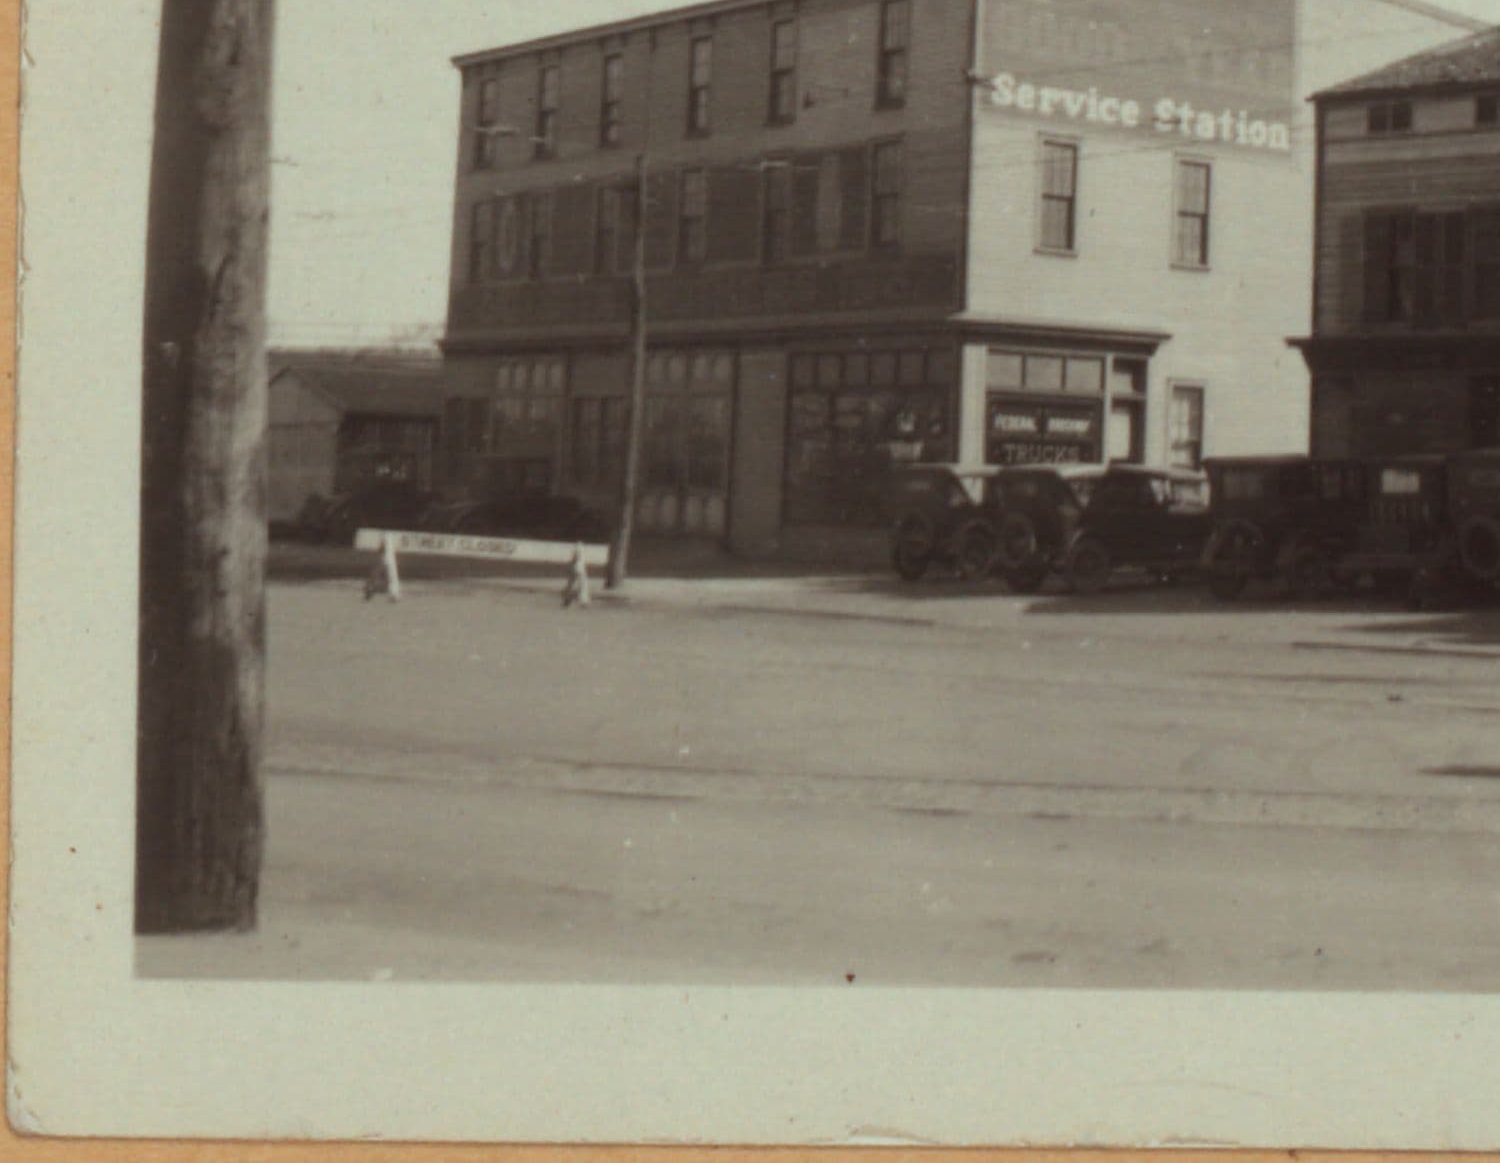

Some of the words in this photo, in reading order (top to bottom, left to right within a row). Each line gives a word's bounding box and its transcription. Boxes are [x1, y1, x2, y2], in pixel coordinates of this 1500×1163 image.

[990, 73, 1140, 128] Service
[1153, 97, 1290, 150] Station
[1004, 443, 1080, 463] TRUCKS
